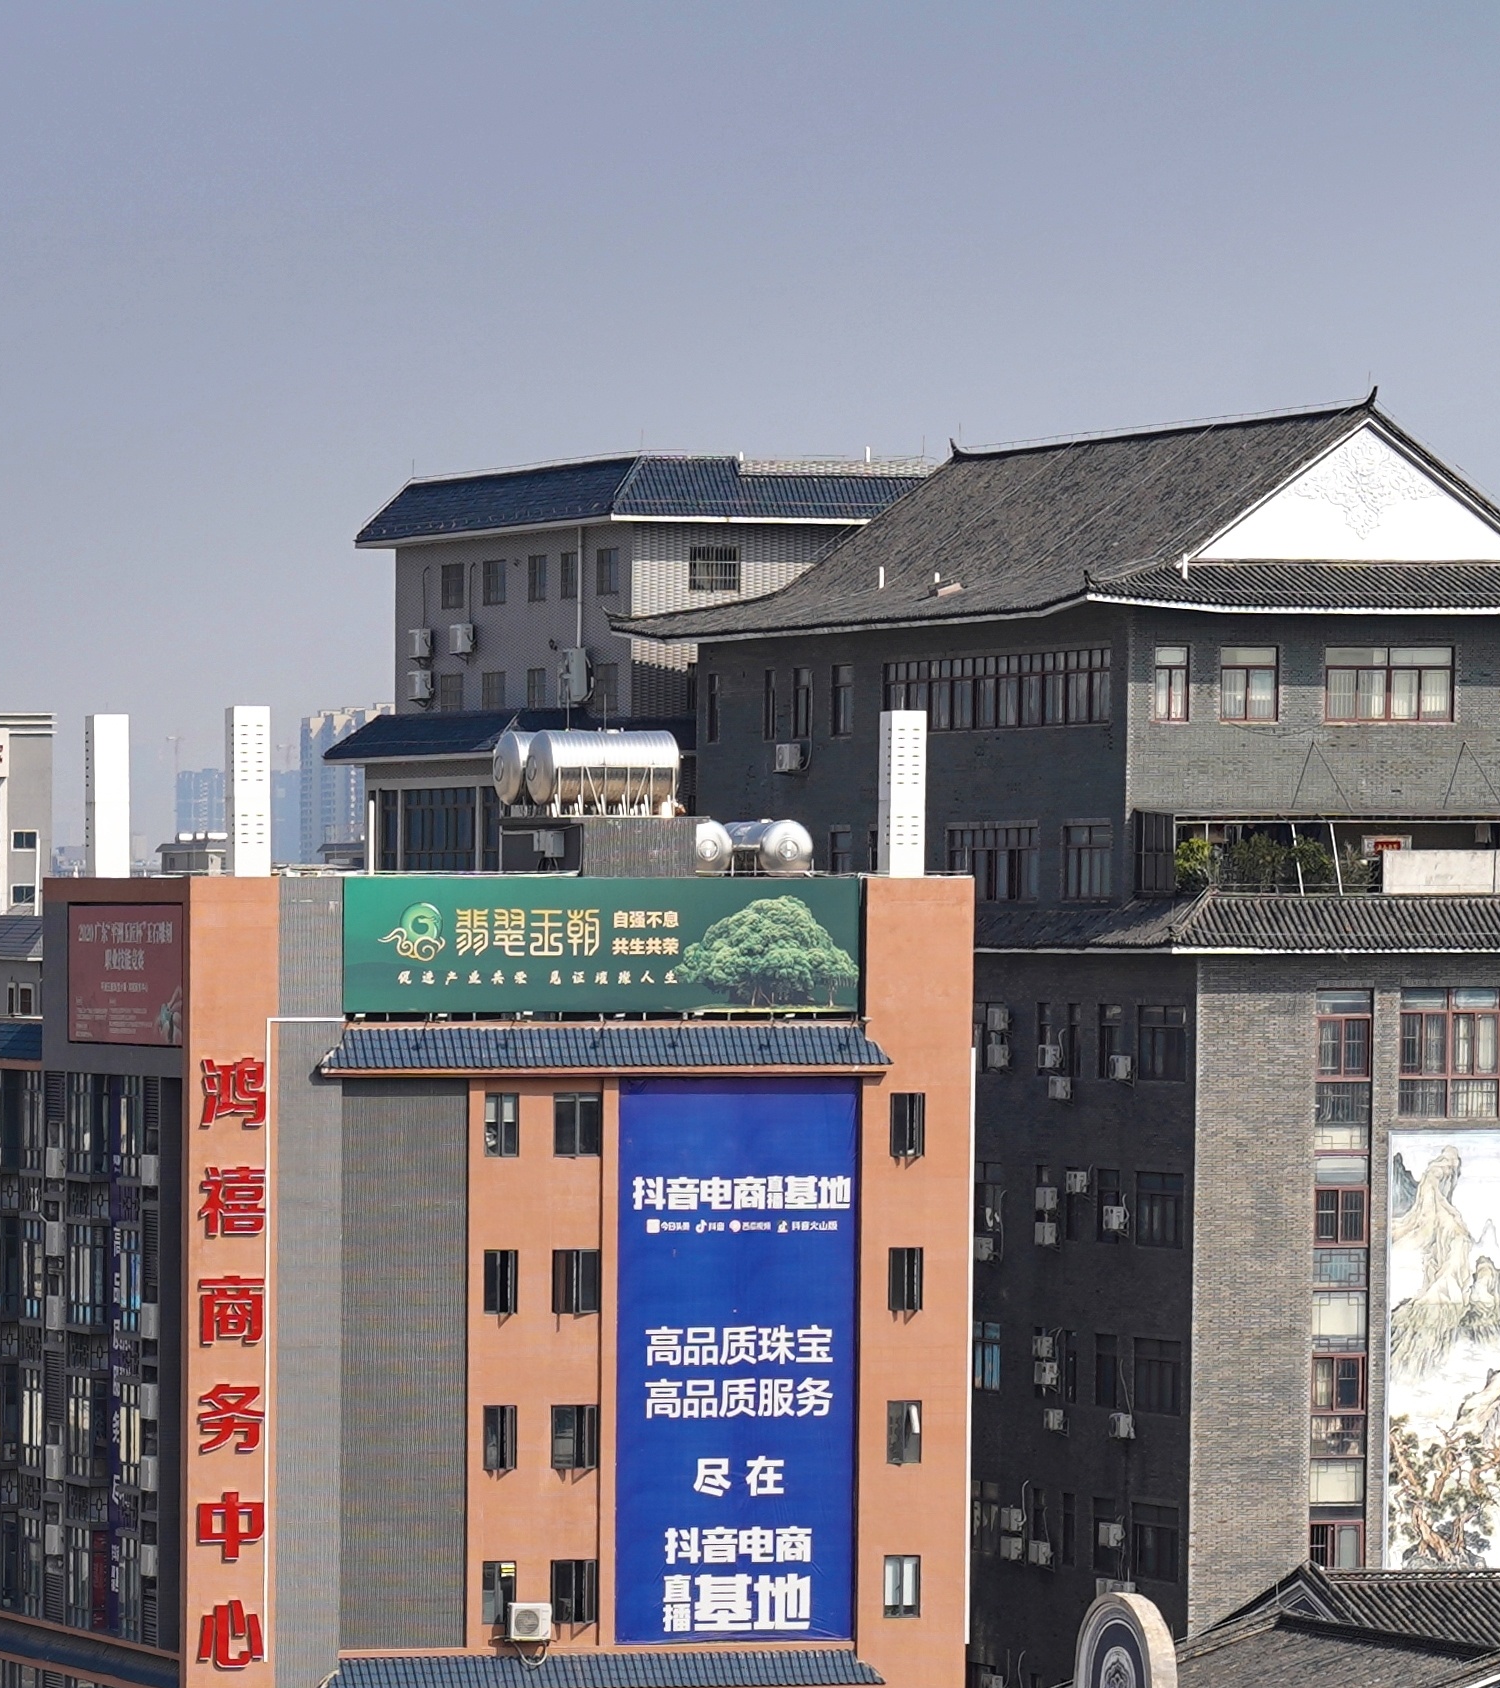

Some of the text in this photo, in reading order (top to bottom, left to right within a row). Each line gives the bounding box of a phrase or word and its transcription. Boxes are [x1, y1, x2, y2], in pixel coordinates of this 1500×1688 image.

[613, 911, 679, 928] 自强不息
[612, 938, 679, 956] 共生共荣
[632, 1176, 851, 1211] 抖音电商直播基地
[197, 1057, 266, 1671] 鸿禧商务中心
[645, 1324, 833, 1366] 高品质珠宝
[644, 1377, 833, 1419] 高品质服务
[693, 1456, 785, 1496] 尽在
[664, 1526, 812, 1564] 抖音电商
[663, 1573, 811, 1632] 直播基地
